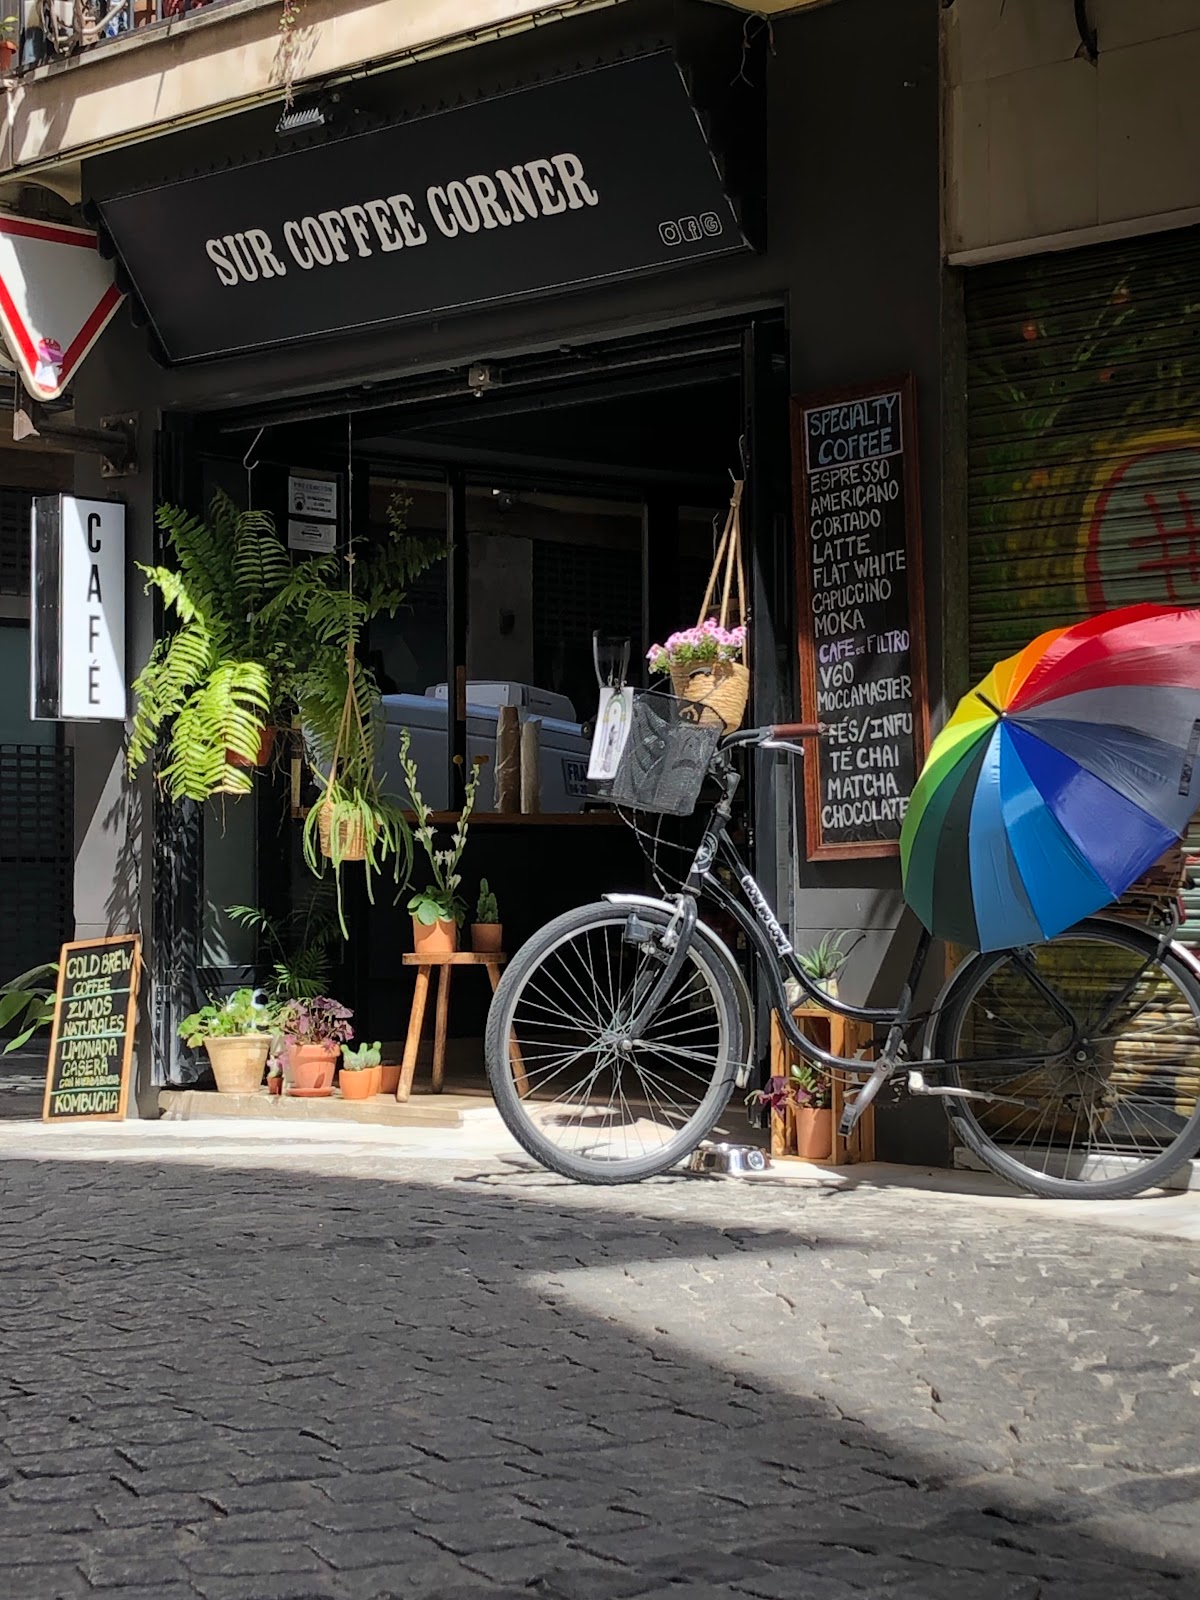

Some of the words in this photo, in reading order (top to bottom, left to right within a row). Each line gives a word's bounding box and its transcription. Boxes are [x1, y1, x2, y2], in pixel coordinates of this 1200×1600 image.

[205, 228, 286, 286] SUR
[283, 193, 428, 270] COFFEE
[426, 152, 600, 239] CORNER
[810, 394, 896, 436] SPECIALTY
[818, 427, 892, 465] COFFEE
[810, 459, 890, 494] ESPRESSO
[811, 480, 899, 517] AMERICANO
[810, 508, 881, 540] CORTADO
[813, 533, 871, 564] LATTE
[813, 562, 850, 588] FLAT
[853, 549, 906, 579] WHITE
[86, 512, 102, 705] CAFÉ
[811, 578, 892, 613] CAPUCCINO
[814, 609, 866, 638] MOKA
[866, 630, 910, 654] FILTRO
[819, 661, 854, 689] V60
[817, 675, 912, 712] MOCCAMASTER
[830, 745, 853, 772] TÉ
[856, 745, 900, 769] CHAI
[827, 772, 900, 800] MATCHA
[821, 796, 911, 829] CHOCOLATE
[66, 953, 100, 980] COLD
[101, 949, 135, 975] BREW
[72, 976, 112, 997] COFFEE
[66, 996, 113, 1019] ZUMOS
[63, 1014, 125, 1037] NATURALES
[61, 1038, 118, 1061] LIMONADA
[62, 1057, 108, 1077] CASERA
[54, 1092, 119, 1114] KOMBUCHA
